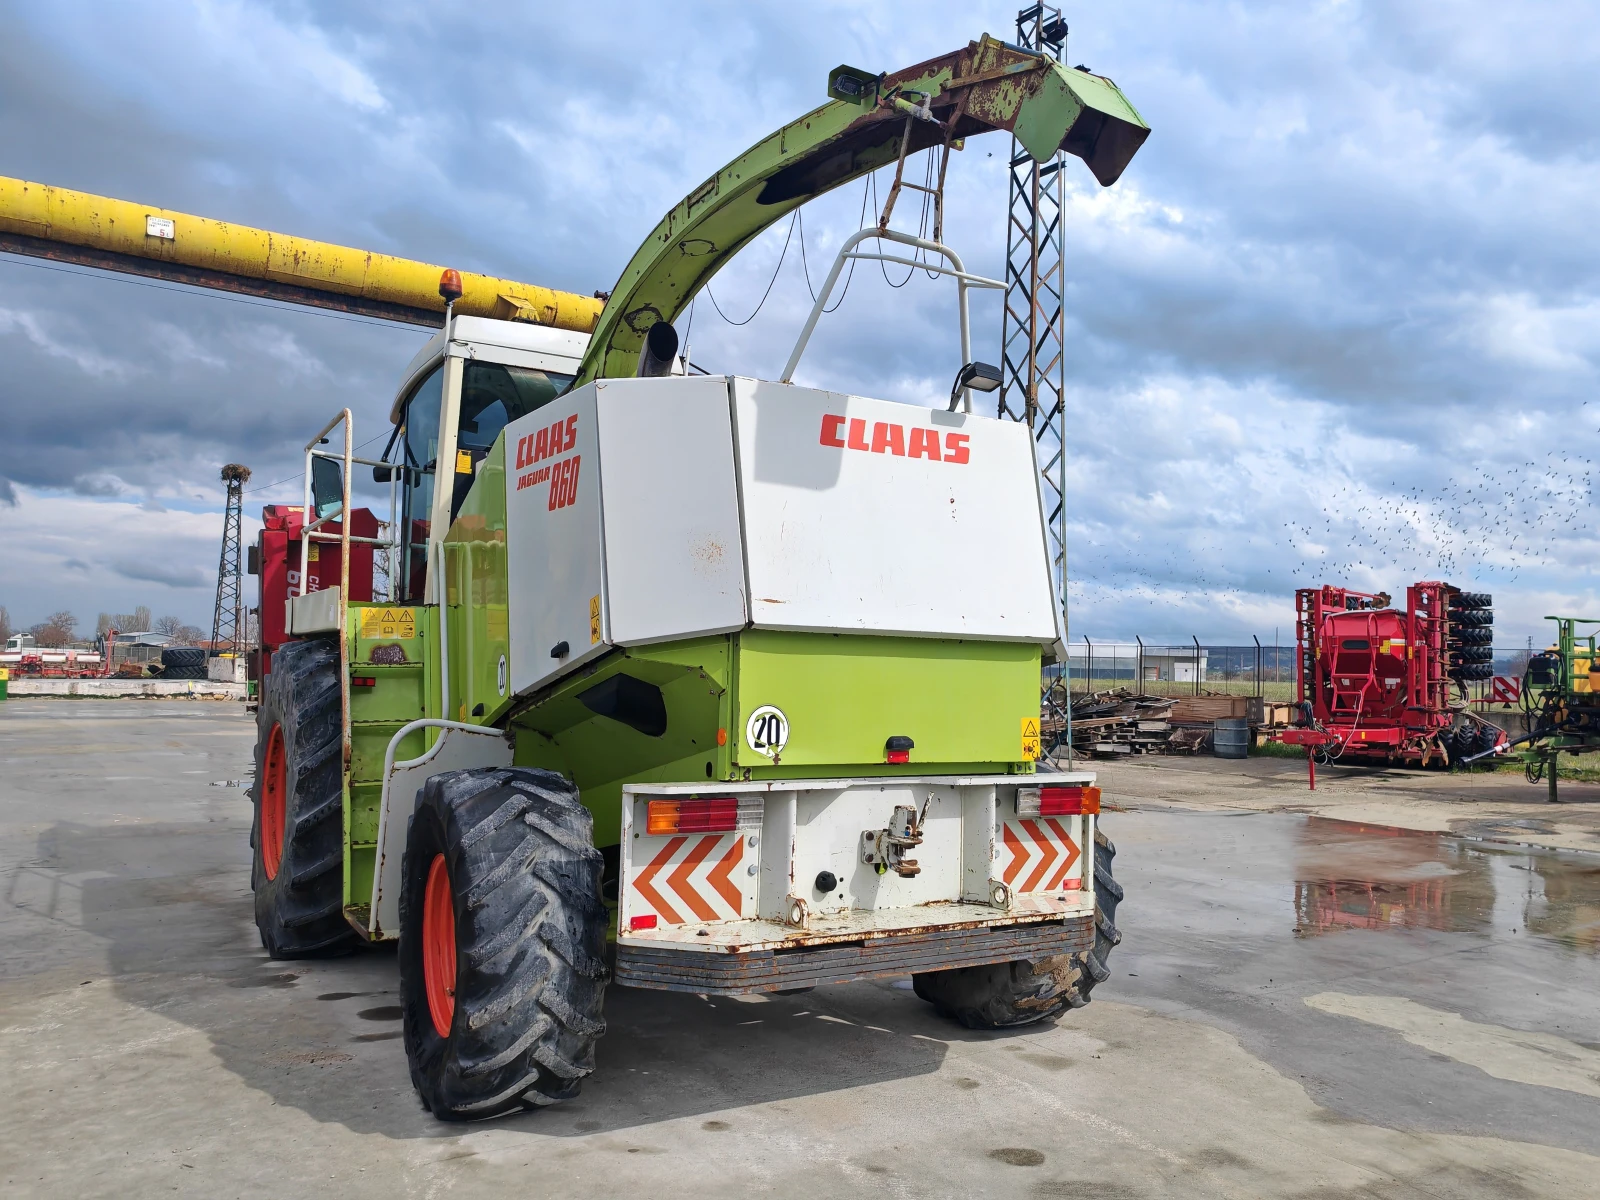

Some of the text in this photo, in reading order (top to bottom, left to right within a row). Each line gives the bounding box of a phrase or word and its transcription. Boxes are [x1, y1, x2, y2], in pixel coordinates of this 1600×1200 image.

[516, 413, 578, 470] CLAAS
[819, 413, 971, 465] CLAAS
[517, 455, 581, 512] JAGUAR 860
[754, 714, 780, 748] 20
